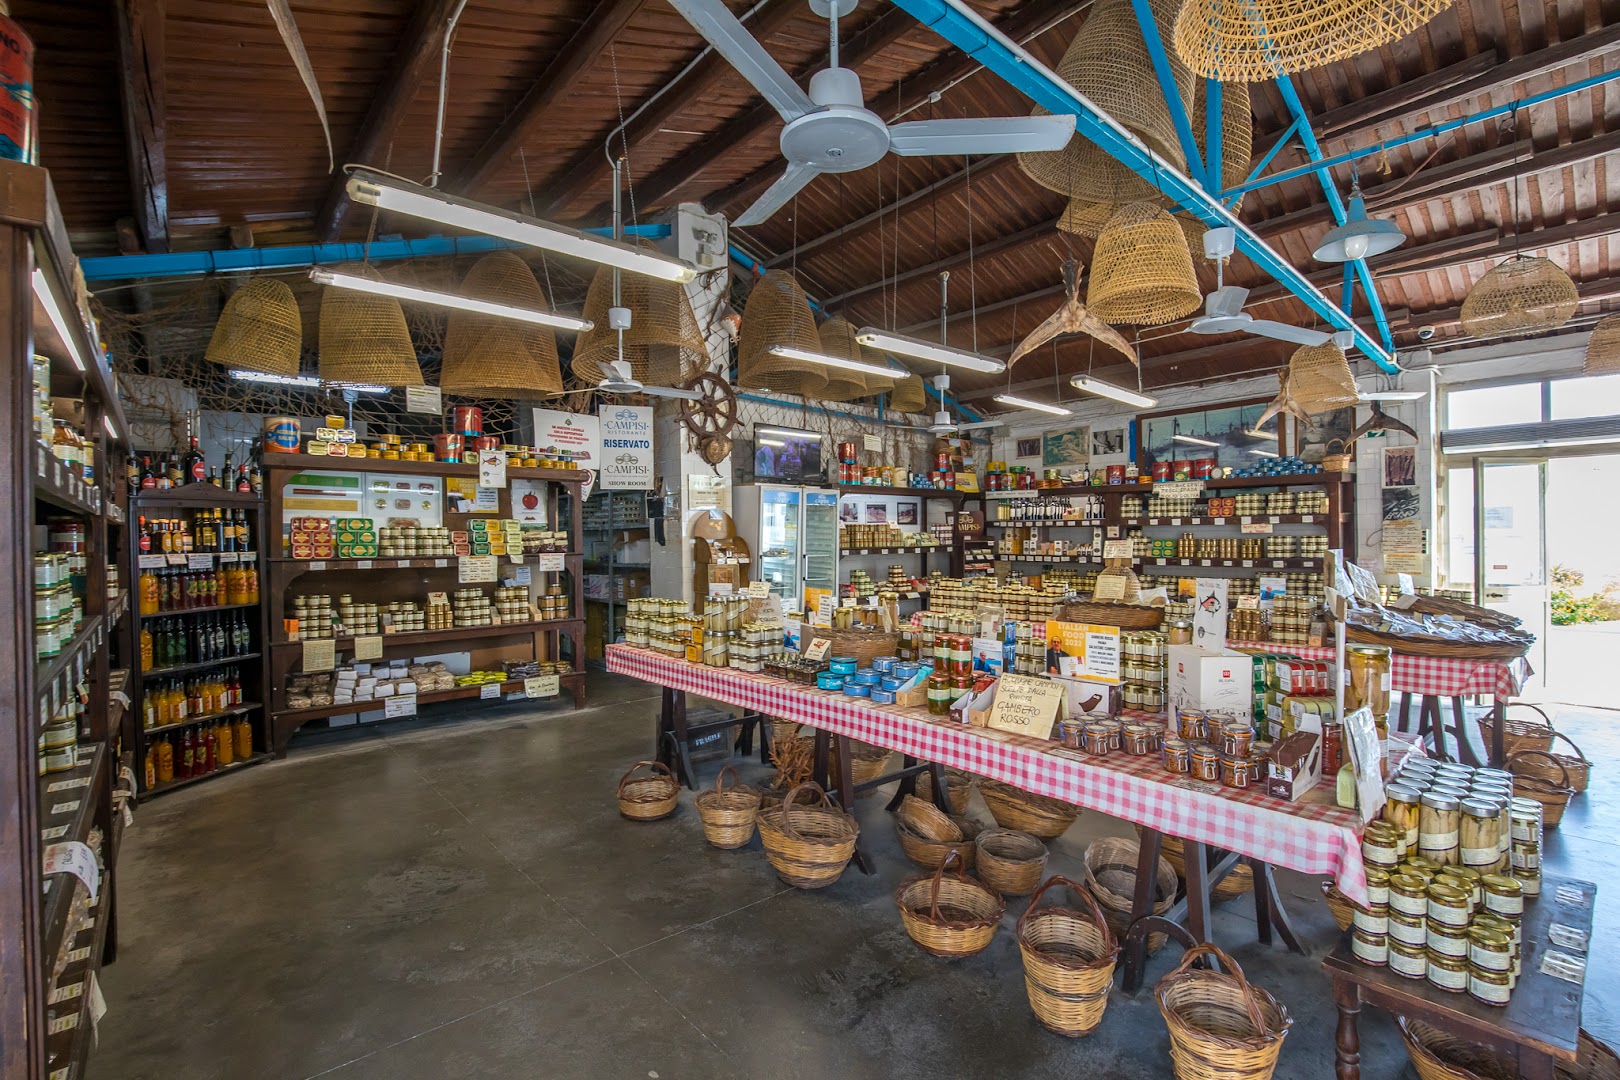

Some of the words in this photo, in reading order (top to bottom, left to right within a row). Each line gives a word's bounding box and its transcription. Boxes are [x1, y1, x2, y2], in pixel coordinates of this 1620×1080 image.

[606, 421, 647, 430] CAMPISI
[603, 439, 650, 449] RISERVATO
[606, 465, 647, 474] CAMPISI
[1058, 622, 1089, 631] ITALIAN
[1062, 631, 1084, 639] FOOD
[1065, 639, 1082, 647] 2022
[1002, 675, 1034, 686] ACCIUGHE
[1034, 680, 1060, 690] CAMPISI
[1000, 685, 1025, 693] SCELTE
[1027, 687, 1046, 696] DALLA
[1009, 693, 1033, 703] RIVISTA
[997, 701, 1041, 716] GAMBERO
[1000, 713, 1030, 725] ROSSO
[695, 731, 721, 746] FRAGILE
